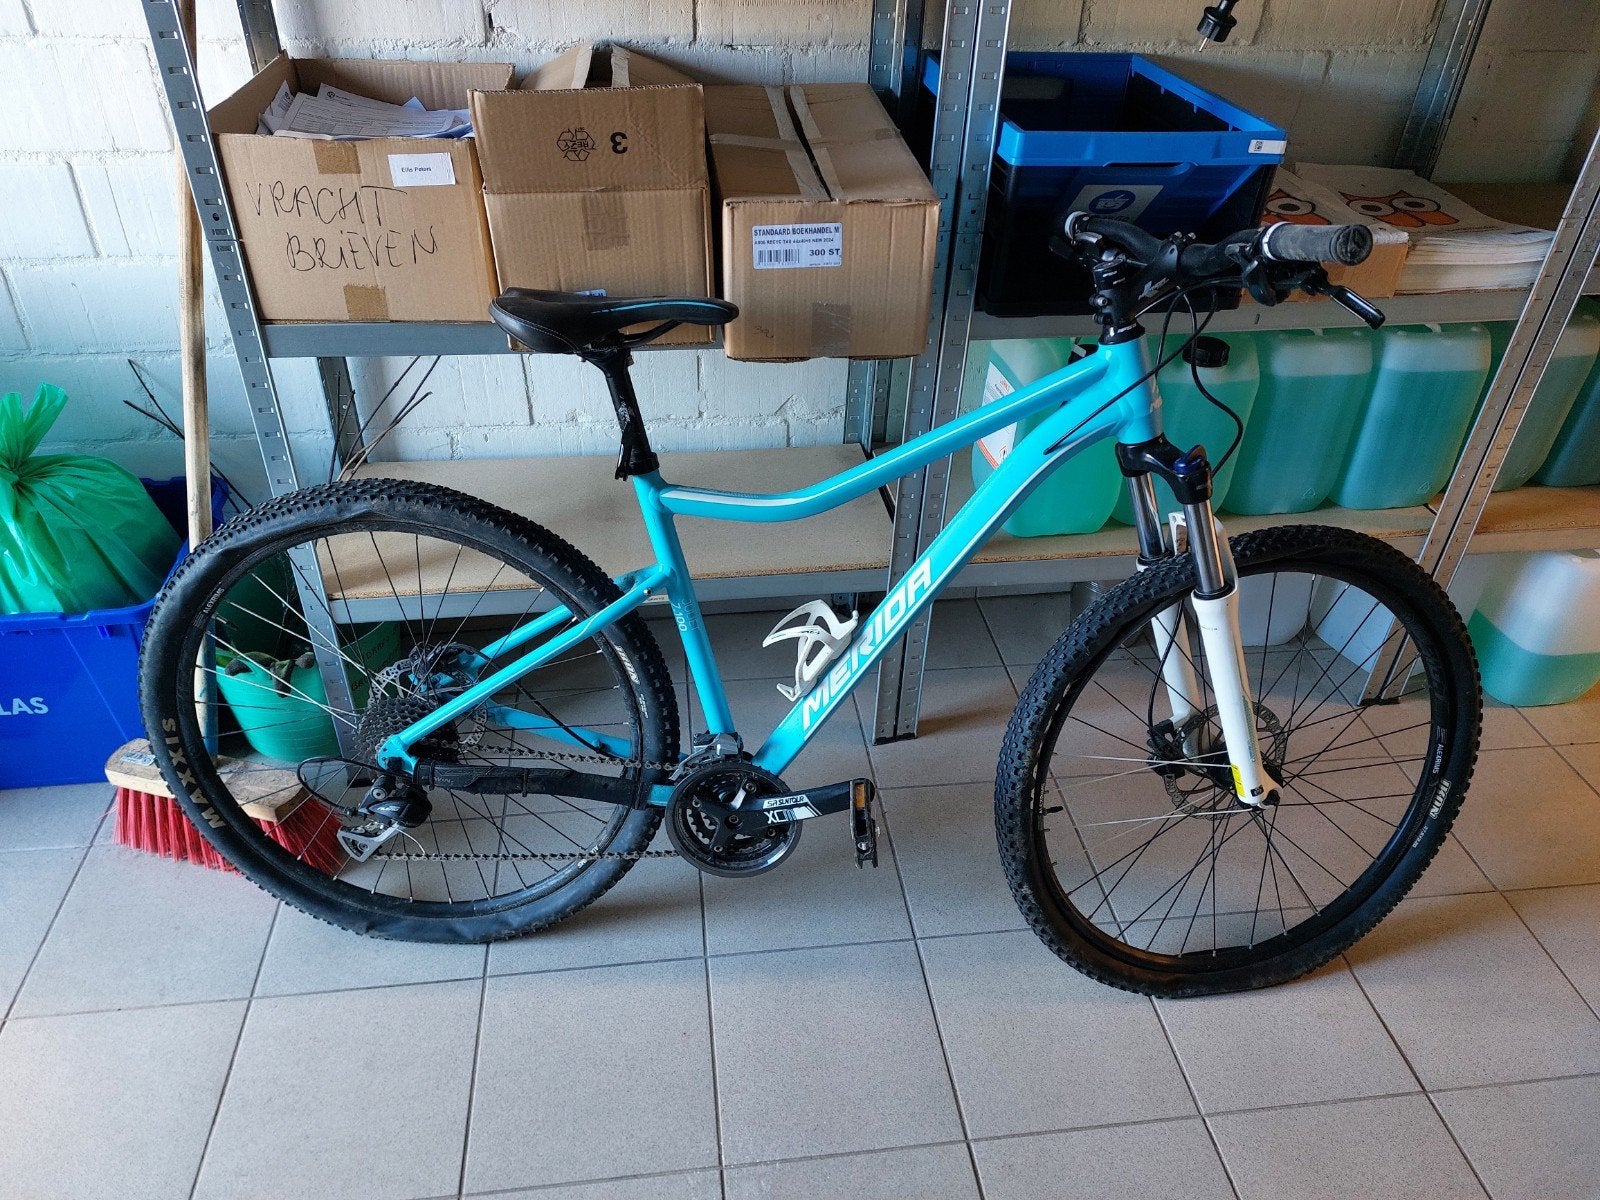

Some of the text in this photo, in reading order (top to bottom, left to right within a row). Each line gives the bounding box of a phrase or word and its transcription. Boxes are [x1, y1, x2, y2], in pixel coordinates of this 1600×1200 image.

[245, 180, 408, 227] VRACHT
[753, 228, 791, 237] STANDAARD
[792, 226, 833, 236] BOEKHANDEL
[809, 248, 841, 257] 300 ST
[802, 557, 932, 730] MERIDA
[162, 718, 226, 829] MAXXIS
